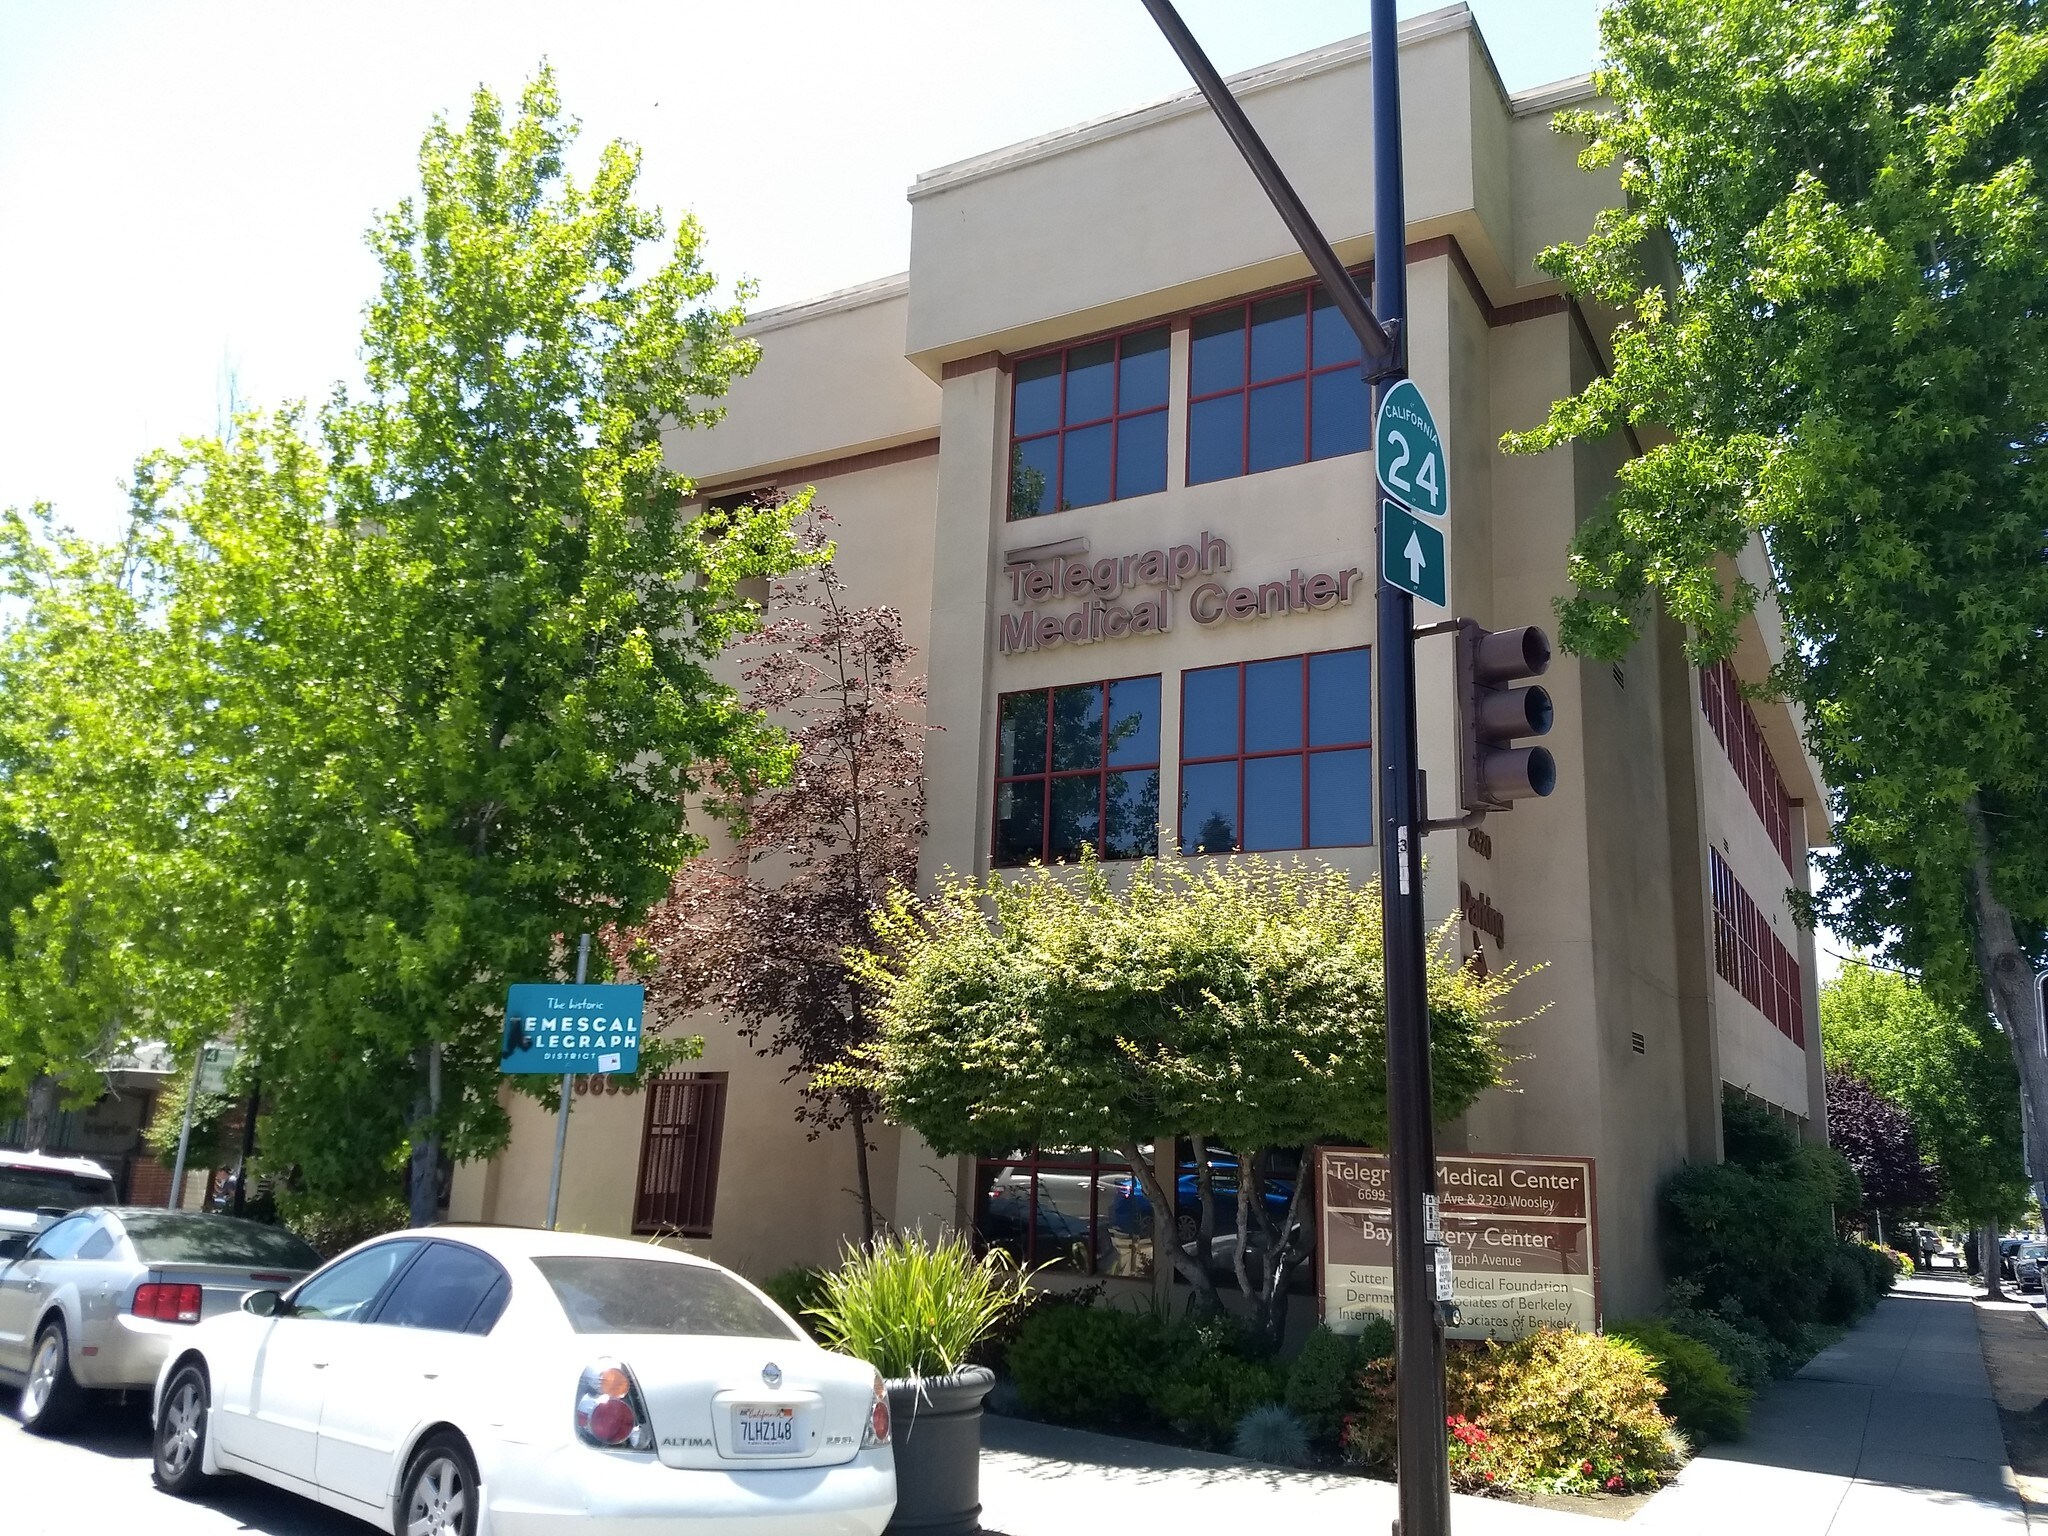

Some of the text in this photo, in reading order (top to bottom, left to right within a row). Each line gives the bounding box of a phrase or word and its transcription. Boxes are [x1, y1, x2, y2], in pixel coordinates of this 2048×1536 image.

[1386, 405, 1438, 447] CALIFORNIA
[1387, 430, 1439, 507] 24
[1003, 530, 1232, 604] Telegraph
[999, 567, 1363, 655] Medical Center
[547, 998, 604, 1010] The historic
[544, 1052, 597, 1060] DISTRICT
[1332, 1161, 1390, 1186] Telegr
[1511, 1169, 1579, 1190] Center
[1358, 1188, 1385, 1201] 6699
[1444, 1193, 1464, 1204] Ave
[1468, 1193, 1476, 1205] &
[1478, 1194, 1506, 1206] 2320
[1508, 1195, 1555, 1210] Woosley
[1363, 1221, 1393, 1246] Bay
[1484, 1227, 1553, 1248] Center
[1481, 1254, 1522, 1267] Avenue
[1349, 1270, 1389, 1285] Sutter
[1499, 1278, 1569, 1293] Foundation
[1502, 1296, 1515, 1309] of
[1518, 1297, 1572, 1315] Berkeley
[1339, 1306, 1385, 1321] Internal
[1513, 1315, 1526, 1328] of
[661, 1437, 713, 1447] ALTIMA
[741, 1422, 792, 1441] 7LHZ148
